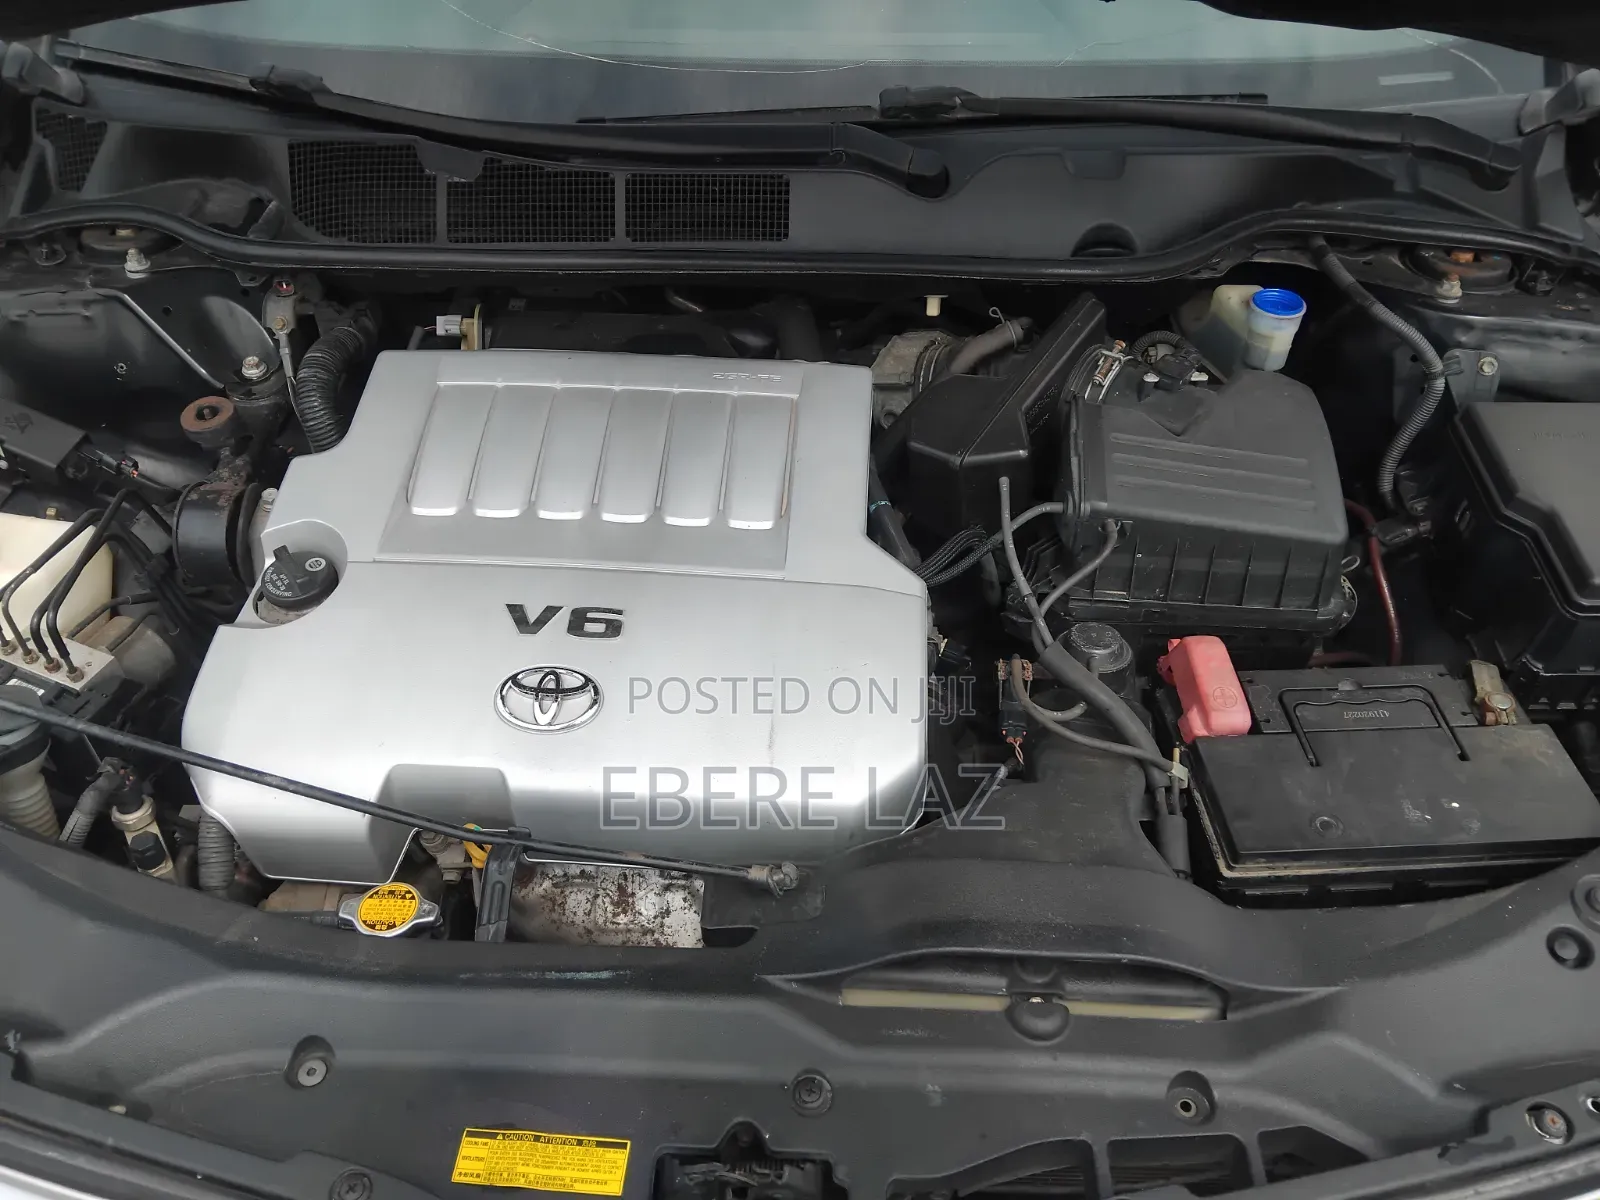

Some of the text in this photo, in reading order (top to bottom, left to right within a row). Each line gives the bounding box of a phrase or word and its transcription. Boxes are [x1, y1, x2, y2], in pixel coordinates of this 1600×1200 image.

[265, 582, 293, 597] CONSERVING
[505, 603, 625, 639] V6
[504, 1133, 535, 1142] CAUTION
[539, 1135, 578, 1146] ATTENTION
